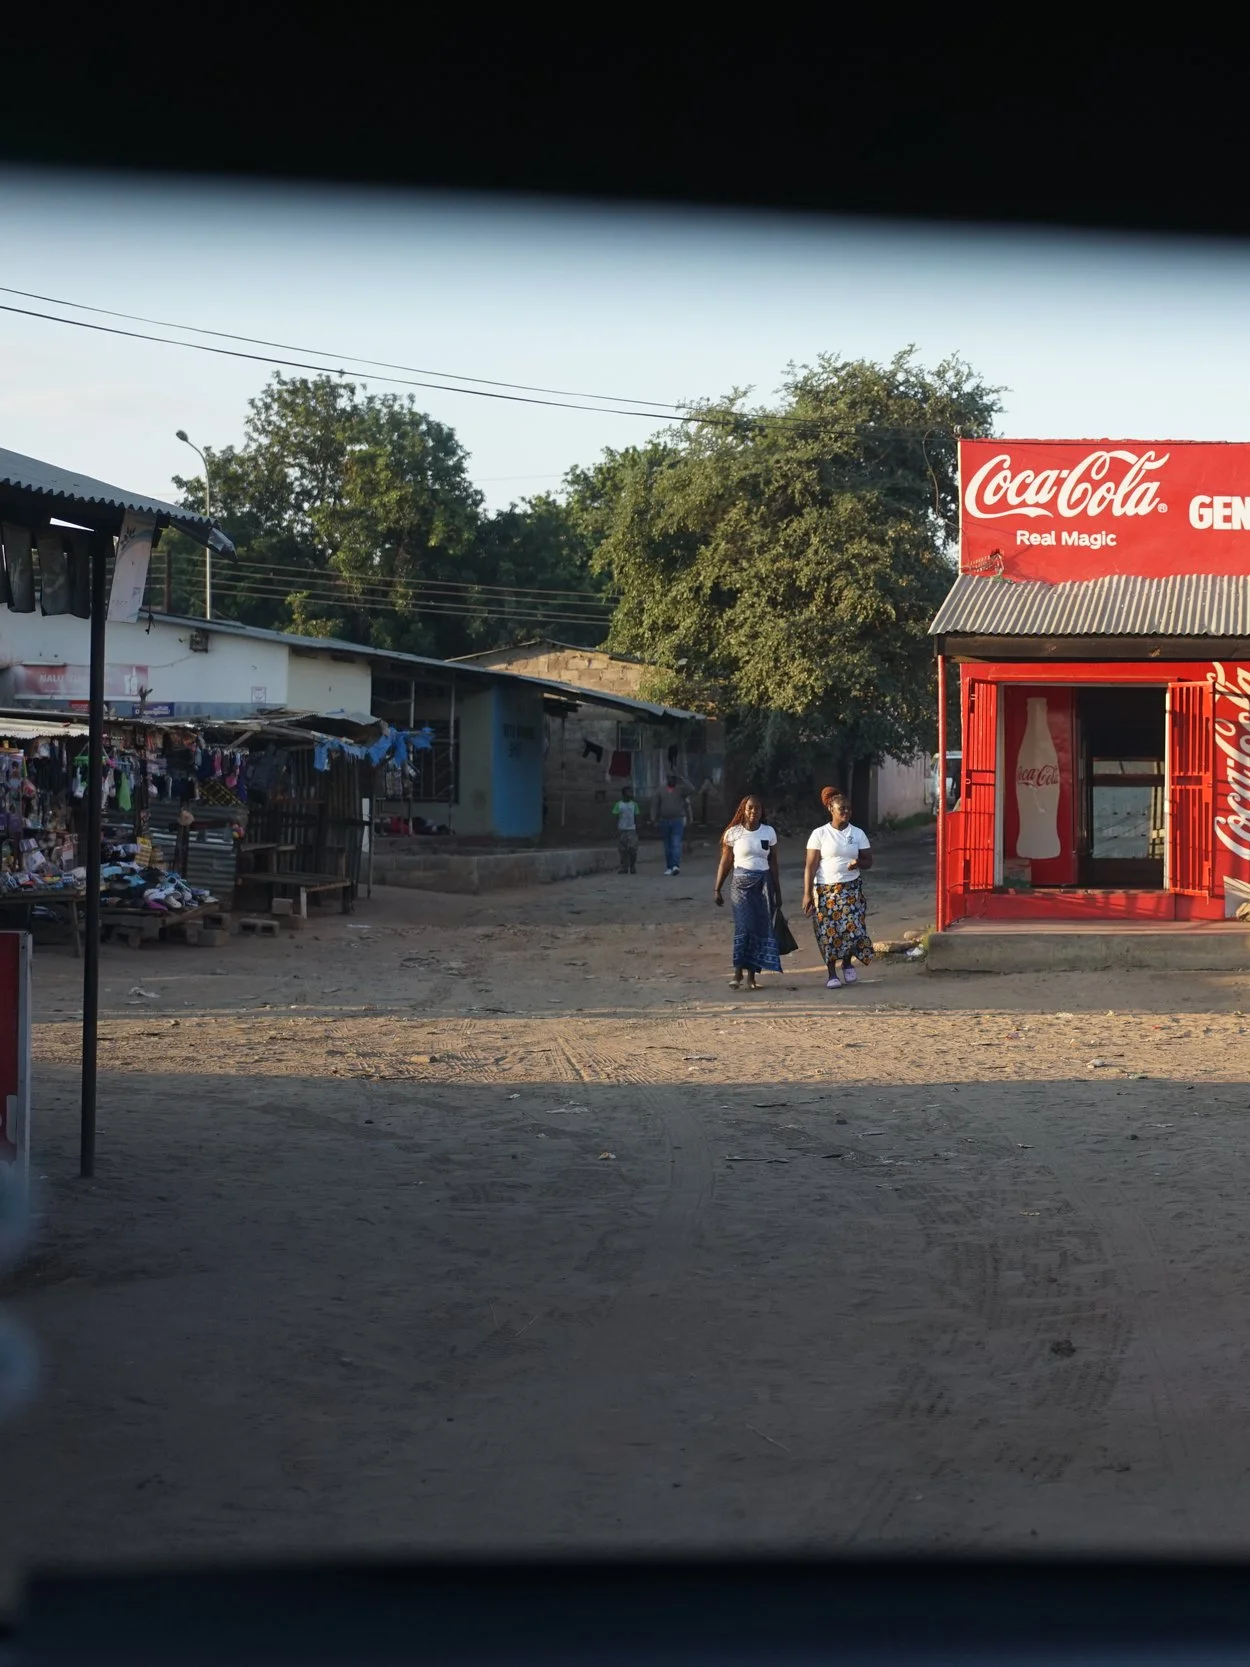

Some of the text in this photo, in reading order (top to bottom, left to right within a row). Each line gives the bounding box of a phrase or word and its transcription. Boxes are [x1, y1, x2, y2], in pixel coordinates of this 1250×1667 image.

[964, 450, 1170, 519] Coca-Cola
[1016, 530, 1117, 549] Real Magic
